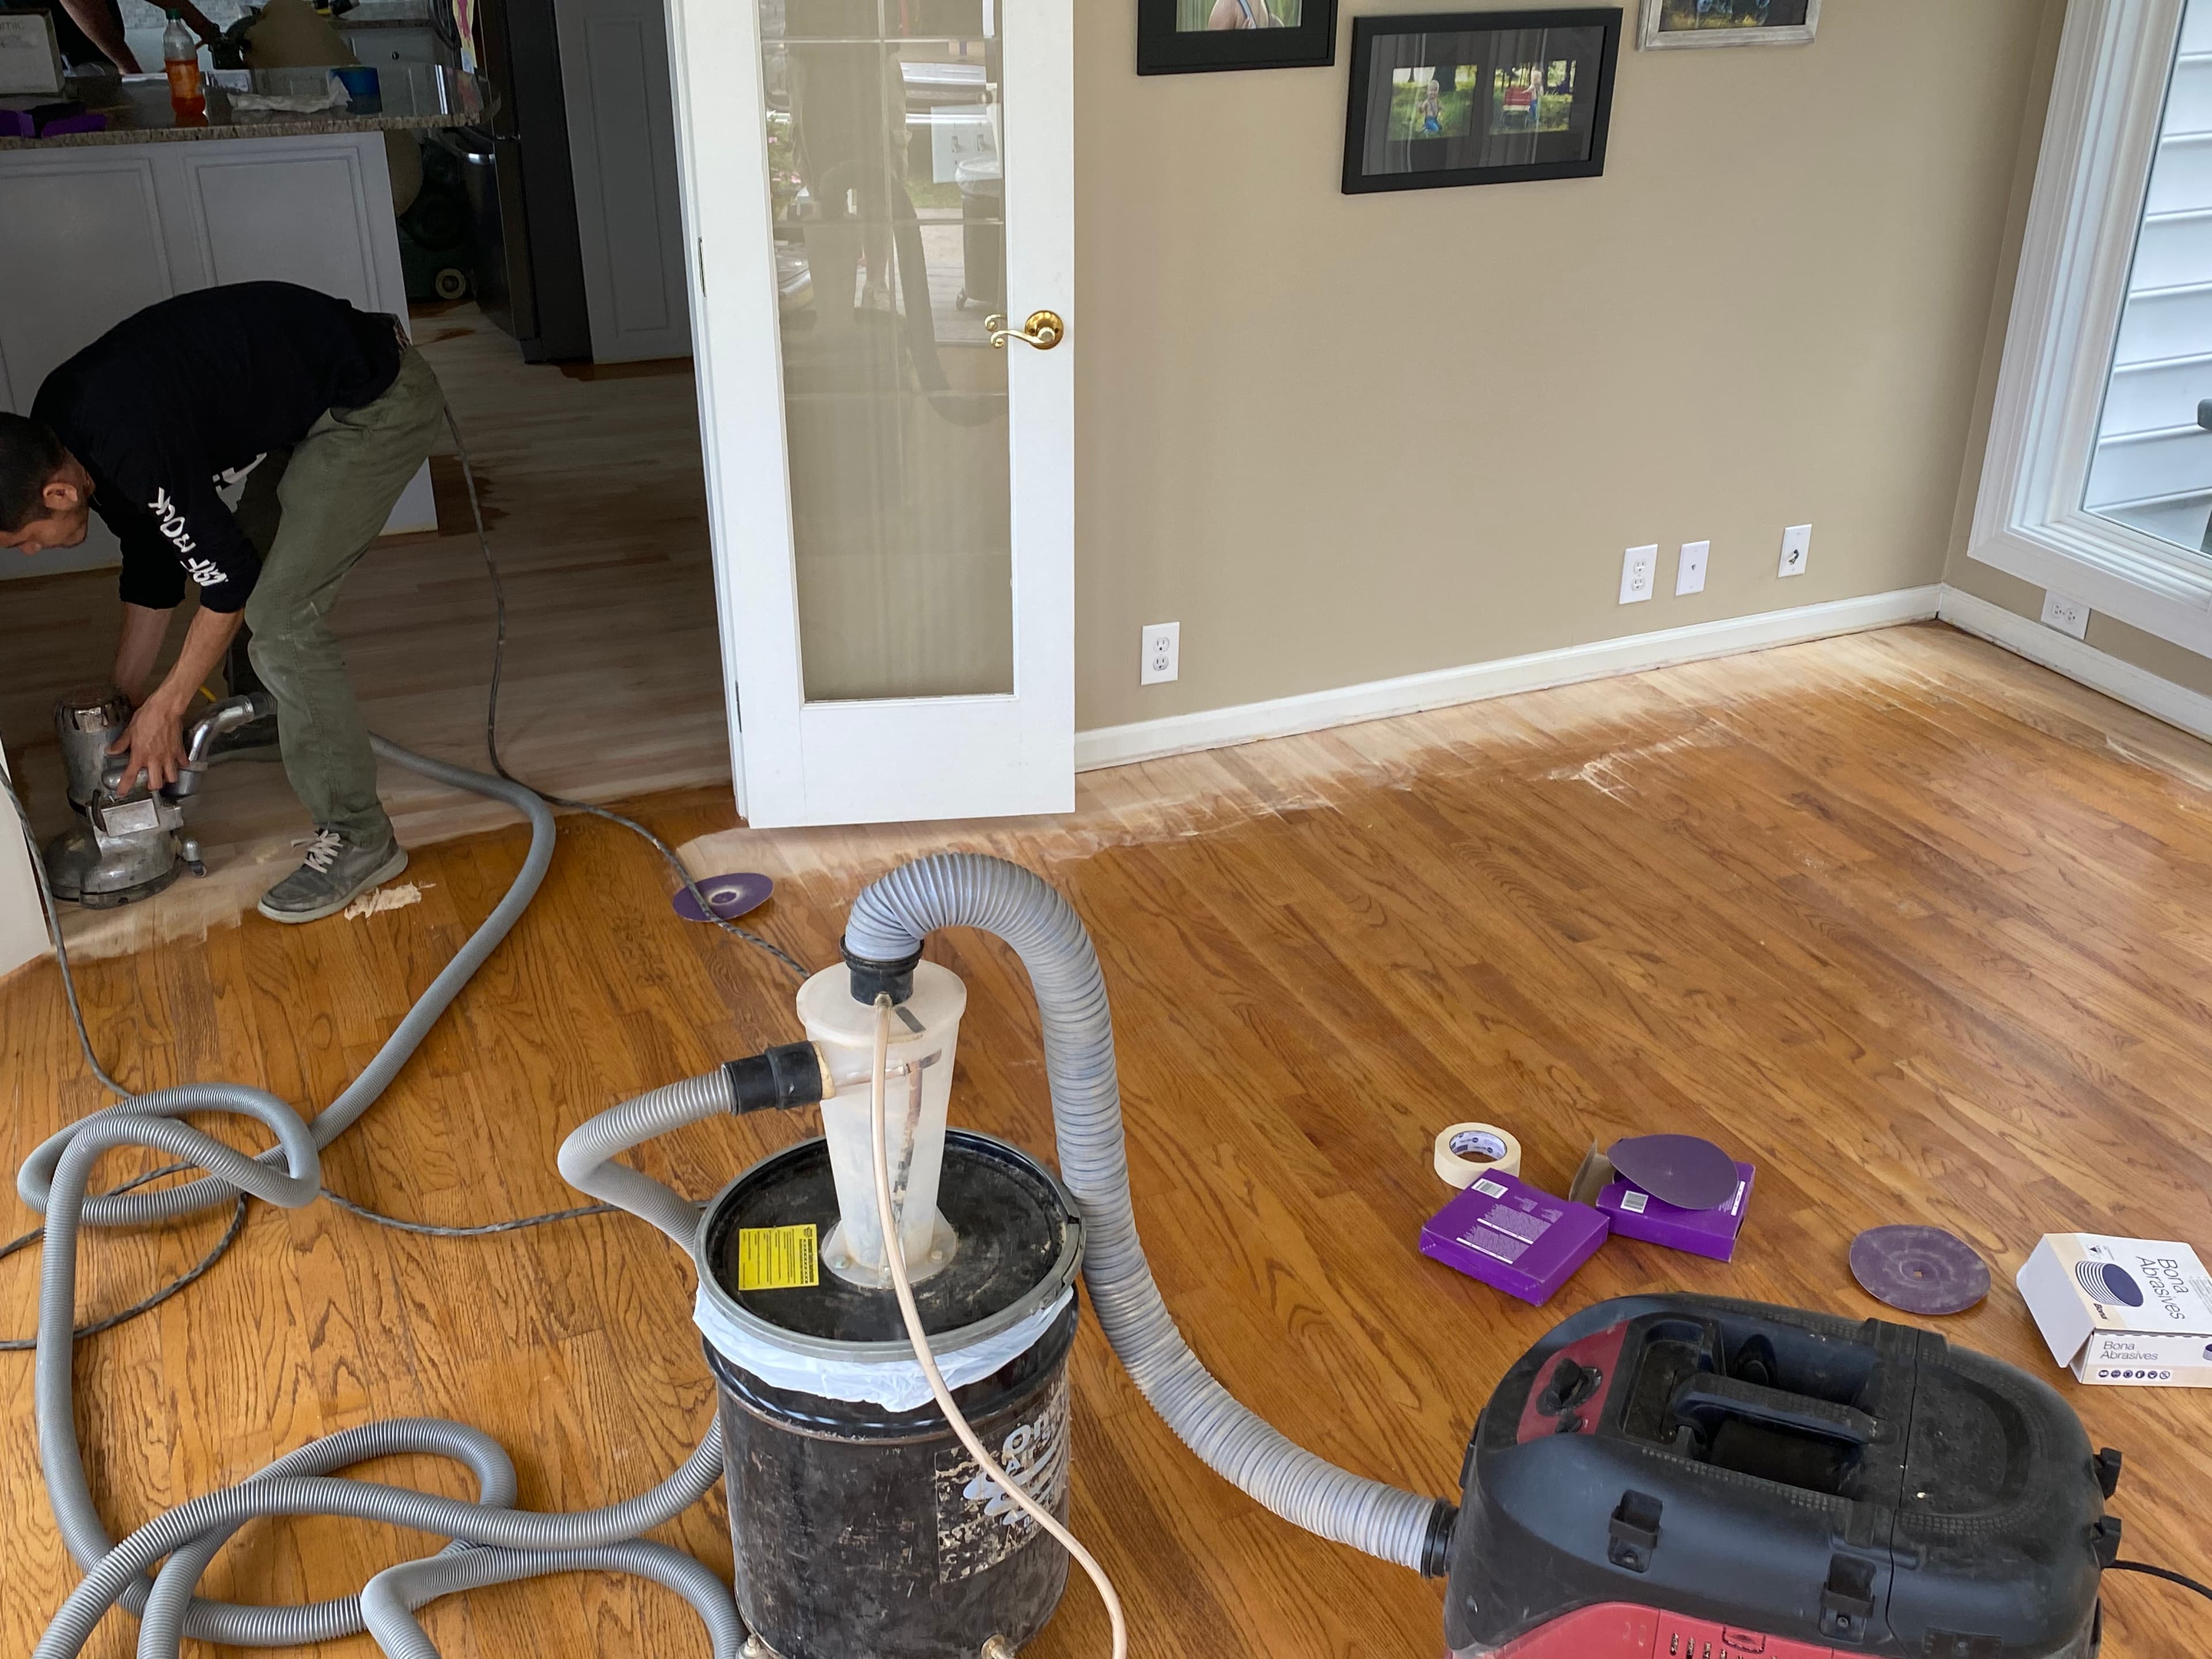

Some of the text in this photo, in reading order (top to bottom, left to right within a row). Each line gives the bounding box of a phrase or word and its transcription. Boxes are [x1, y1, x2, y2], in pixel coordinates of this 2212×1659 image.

[2157, 1259, 2188, 1293] Bona
[2135, 1256, 2185, 1319] Abrasives
[2100, 1350, 2158, 1360] Abrasives
[2103, 1341, 2135, 1351] Bona
